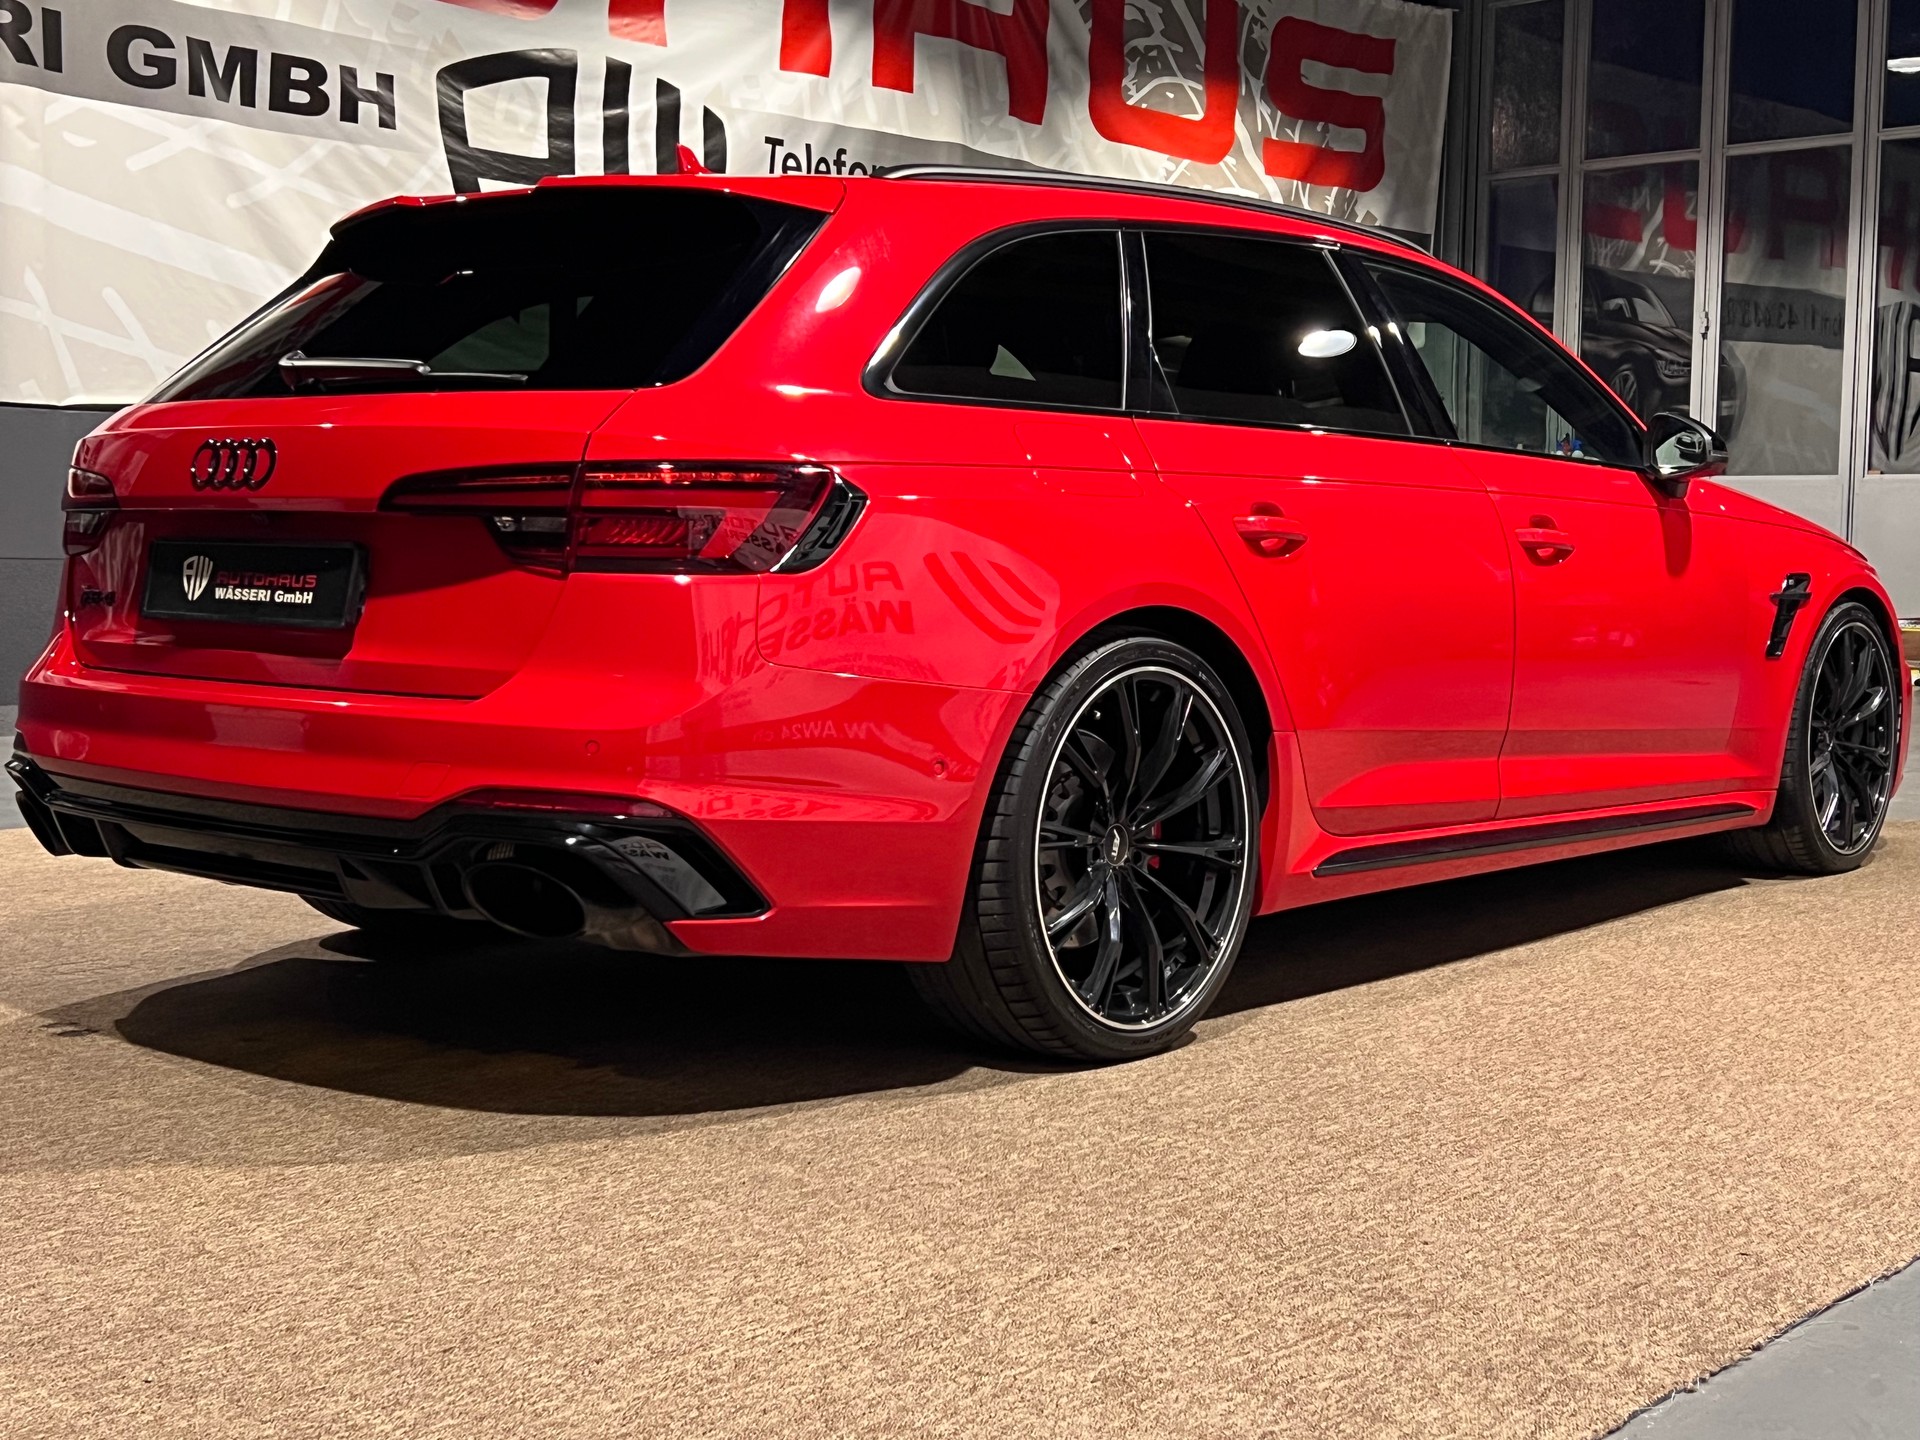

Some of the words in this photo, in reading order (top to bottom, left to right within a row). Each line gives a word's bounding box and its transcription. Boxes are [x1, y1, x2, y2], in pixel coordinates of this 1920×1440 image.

[106, 24, 397, 131] GMBH
[216, 571, 318, 588] AUTOHAUS
[214, 586, 271, 602] WÄSSERI
[274, 590, 314, 605] GmbH
